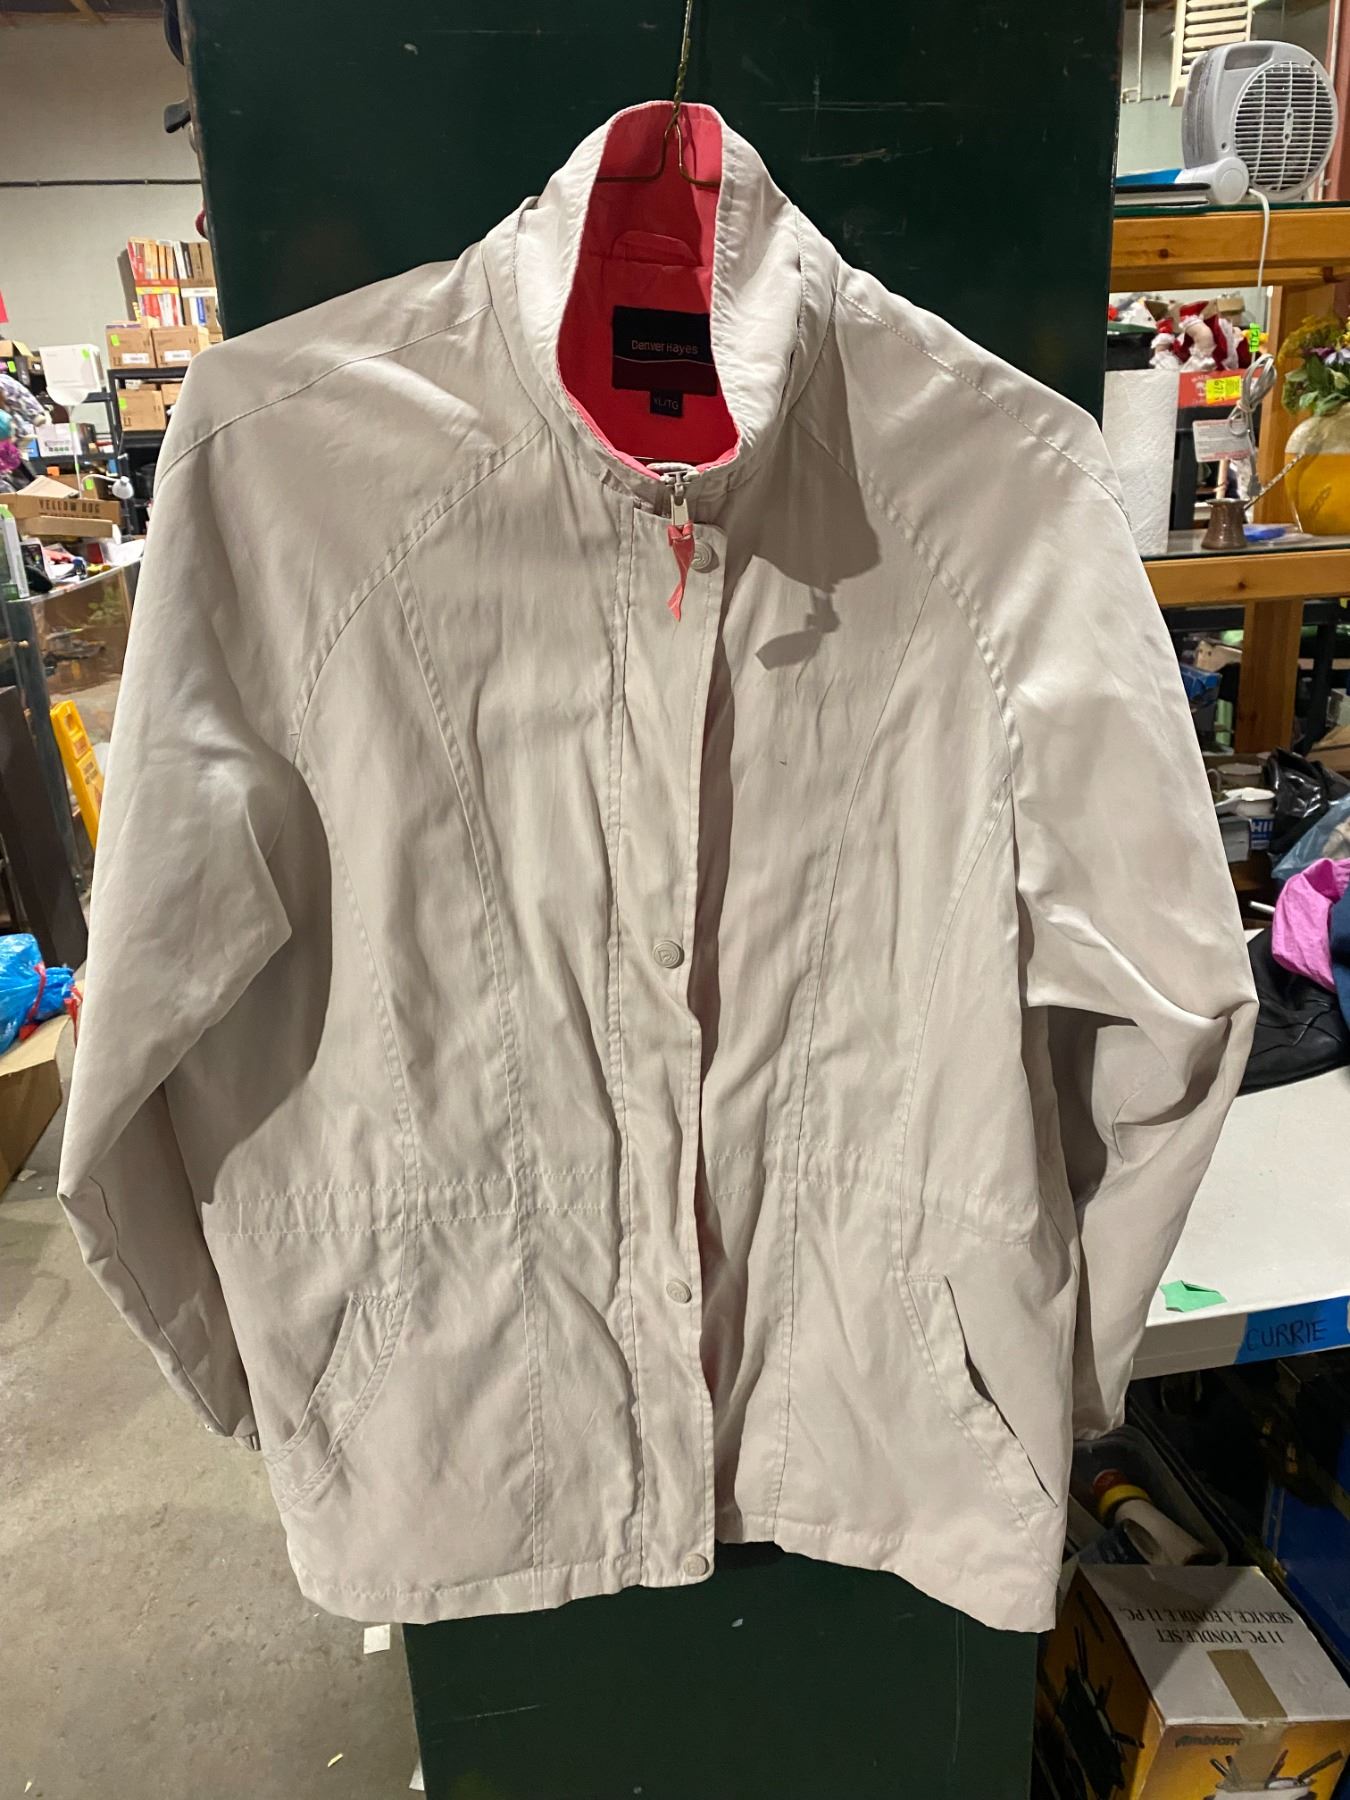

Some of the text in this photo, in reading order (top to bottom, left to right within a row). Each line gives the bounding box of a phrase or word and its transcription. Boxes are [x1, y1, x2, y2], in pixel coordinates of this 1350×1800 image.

[631, 340, 665, 352] Denver
[1246, 1319, 1328, 1352] CURRIE
[1168, 1609, 1227, 1623] FONDUE
[1239, 1611, 1294, 1624] SERVICE
[1156, 1629, 1186, 1643] SET
[1187, 1629, 1242, 1644] FONDUE
[1268, 1630, 1285, 1644] 11
